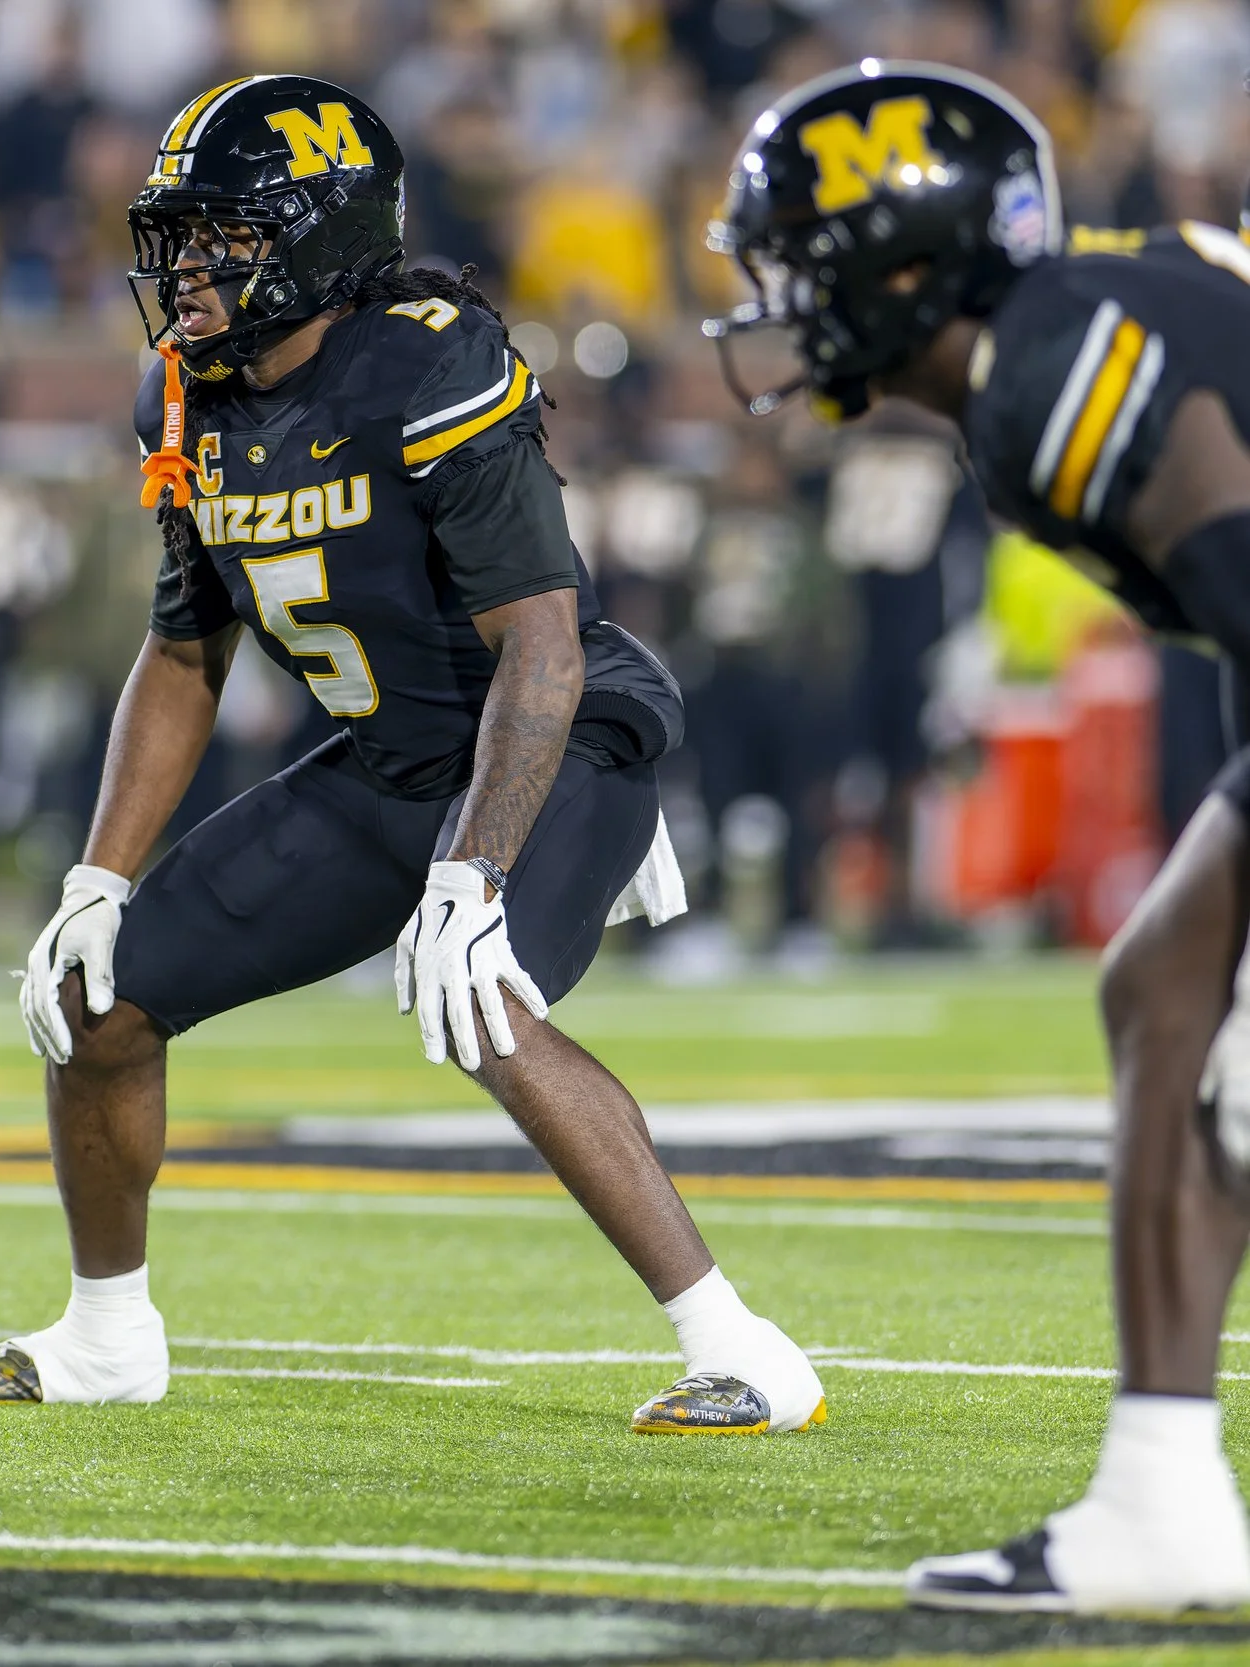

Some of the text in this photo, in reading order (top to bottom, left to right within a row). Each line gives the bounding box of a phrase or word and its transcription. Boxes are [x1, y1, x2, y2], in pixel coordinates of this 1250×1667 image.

[264, 102, 374, 180] M
[798, 95, 944, 214] M
[387, 297, 460, 332] 5
[164, 402, 181, 447] NXTRND
[196, 432, 224, 497] C
[188, 473, 372, 547] MIZZOU
[241, 547, 380, 717] 5
